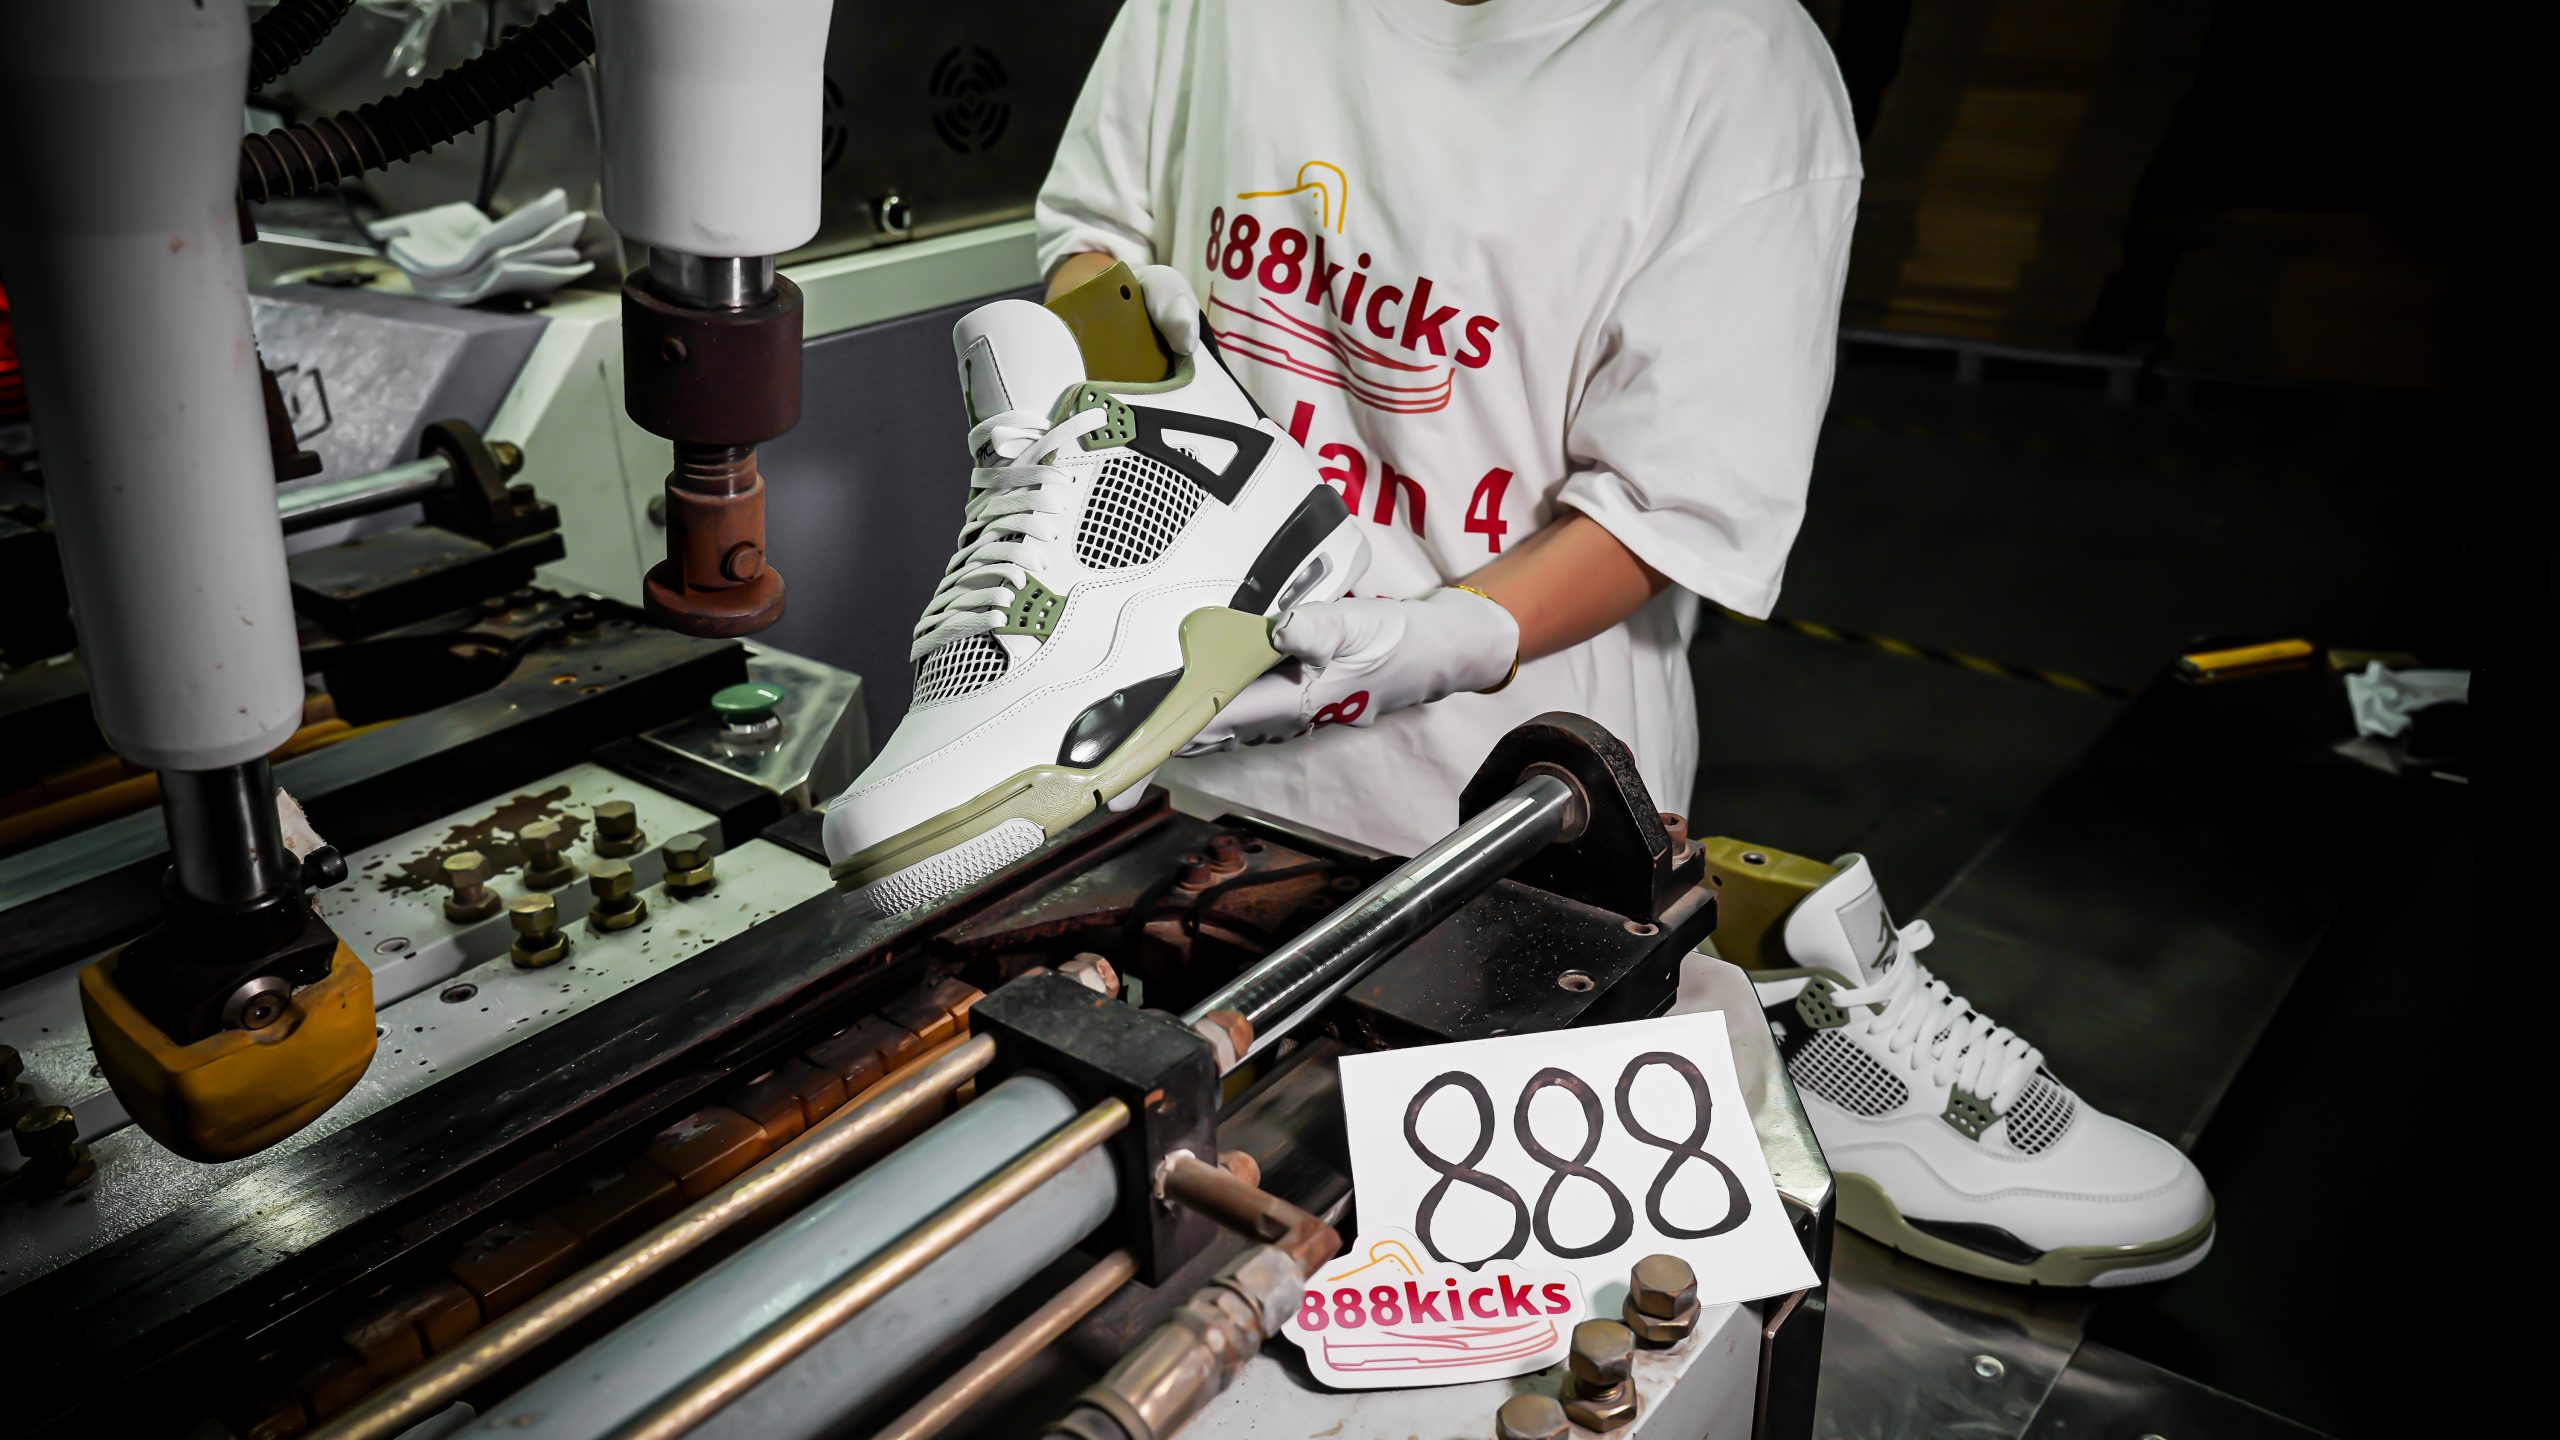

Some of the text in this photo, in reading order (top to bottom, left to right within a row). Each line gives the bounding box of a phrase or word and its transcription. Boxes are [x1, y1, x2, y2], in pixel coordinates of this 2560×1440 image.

[1205, 205, 1500, 370] 888kicks
[1277, 400, 1514, 554] an 4
[1403, 1051, 1752, 1272] 888
[1297, 1274, 1572, 1332] 888kicks
